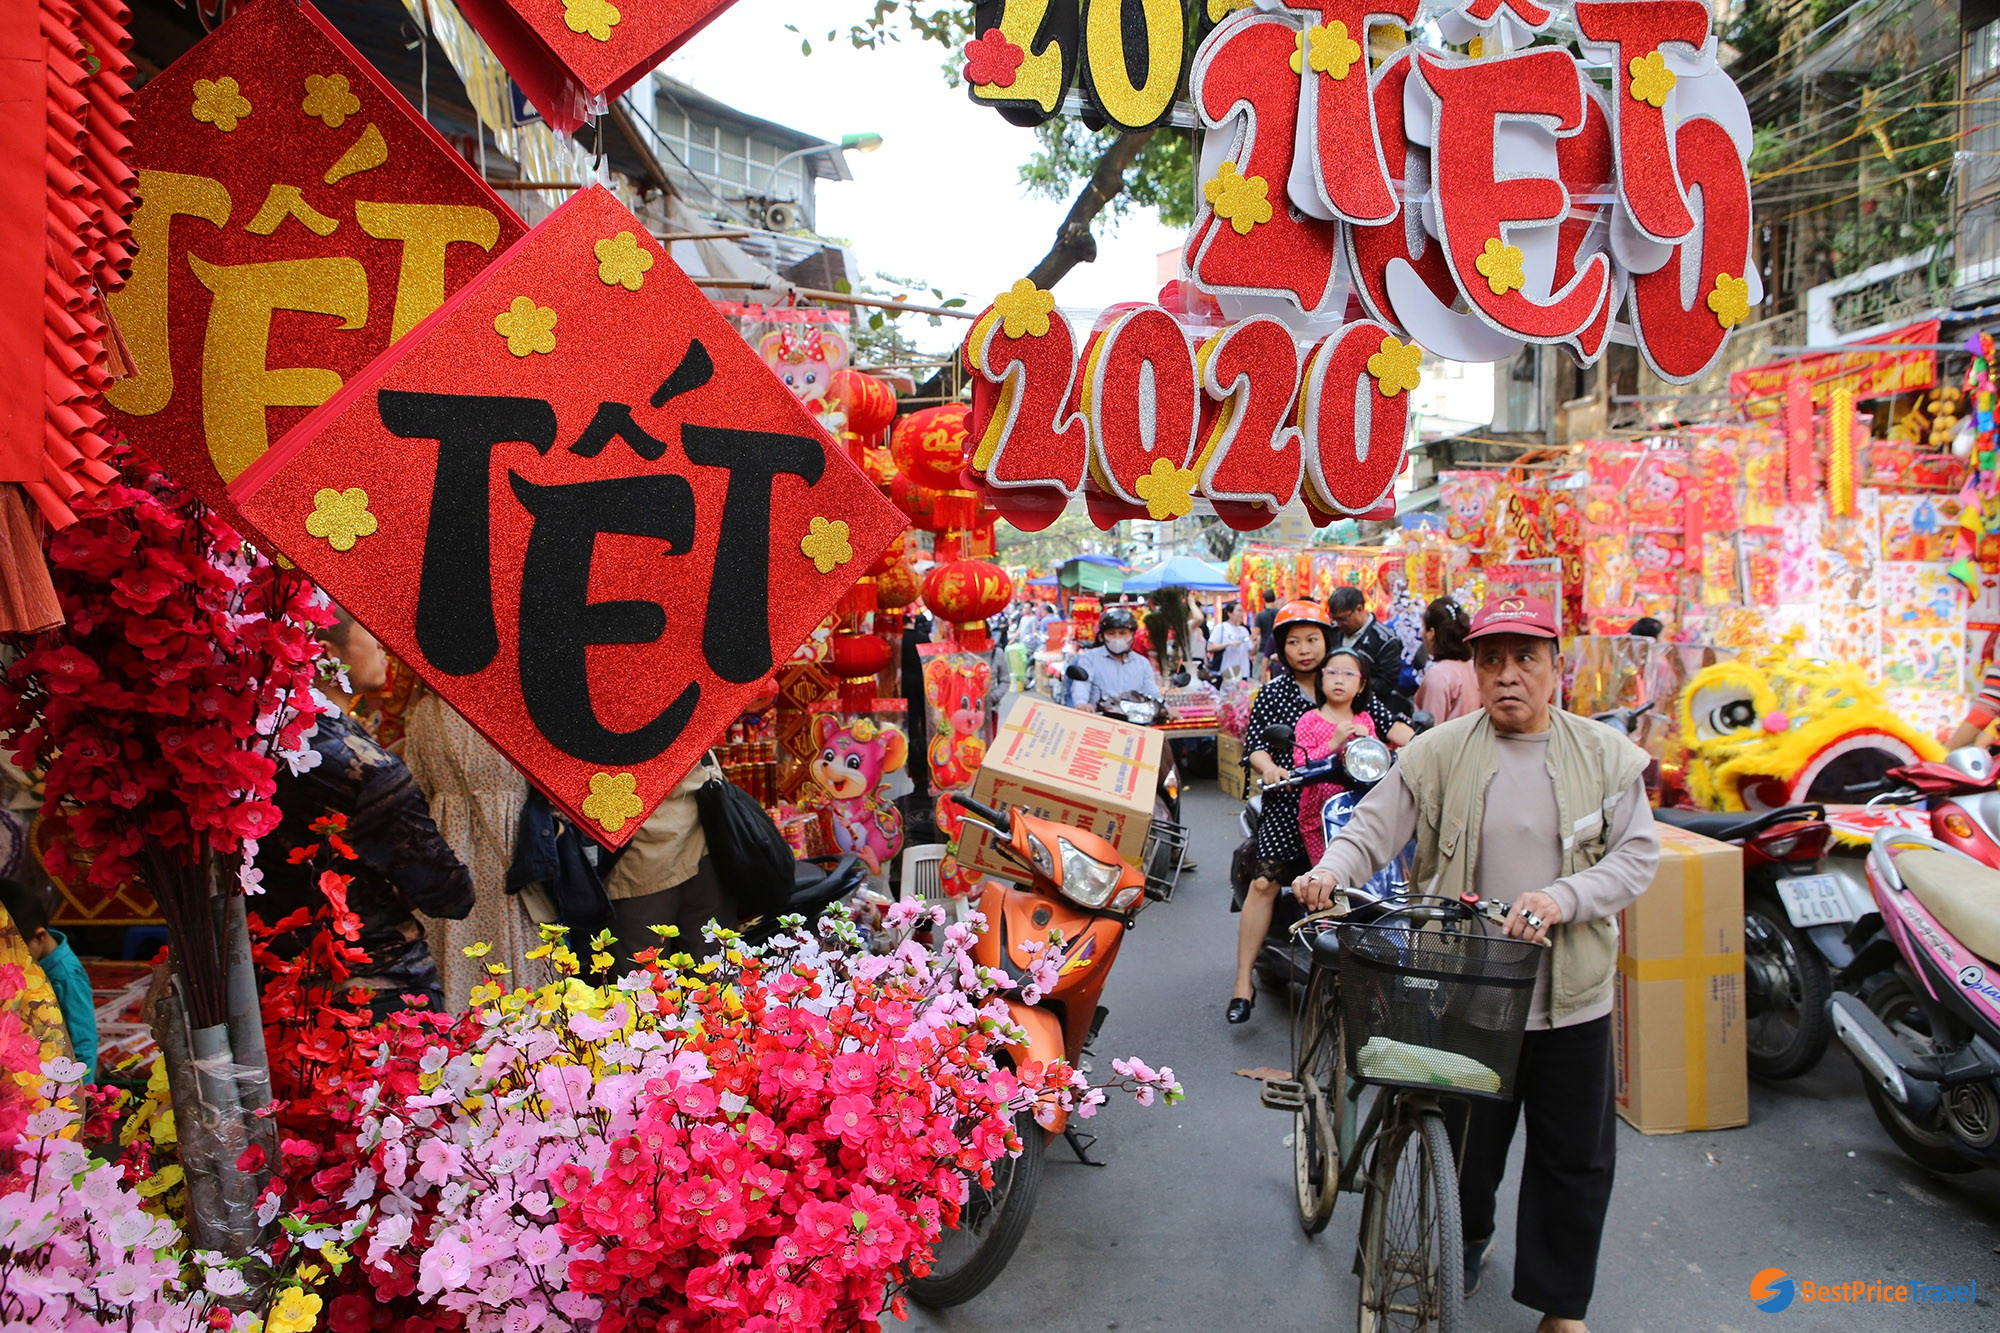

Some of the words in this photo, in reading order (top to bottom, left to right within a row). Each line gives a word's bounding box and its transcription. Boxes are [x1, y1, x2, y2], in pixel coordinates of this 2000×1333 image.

[980, 303, 1413, 516] 2020
[378, 338, 825, 766] TẾT
[1080, 726, 1113, 750] HOA
[1799, 900, 1845, 920] 4401
